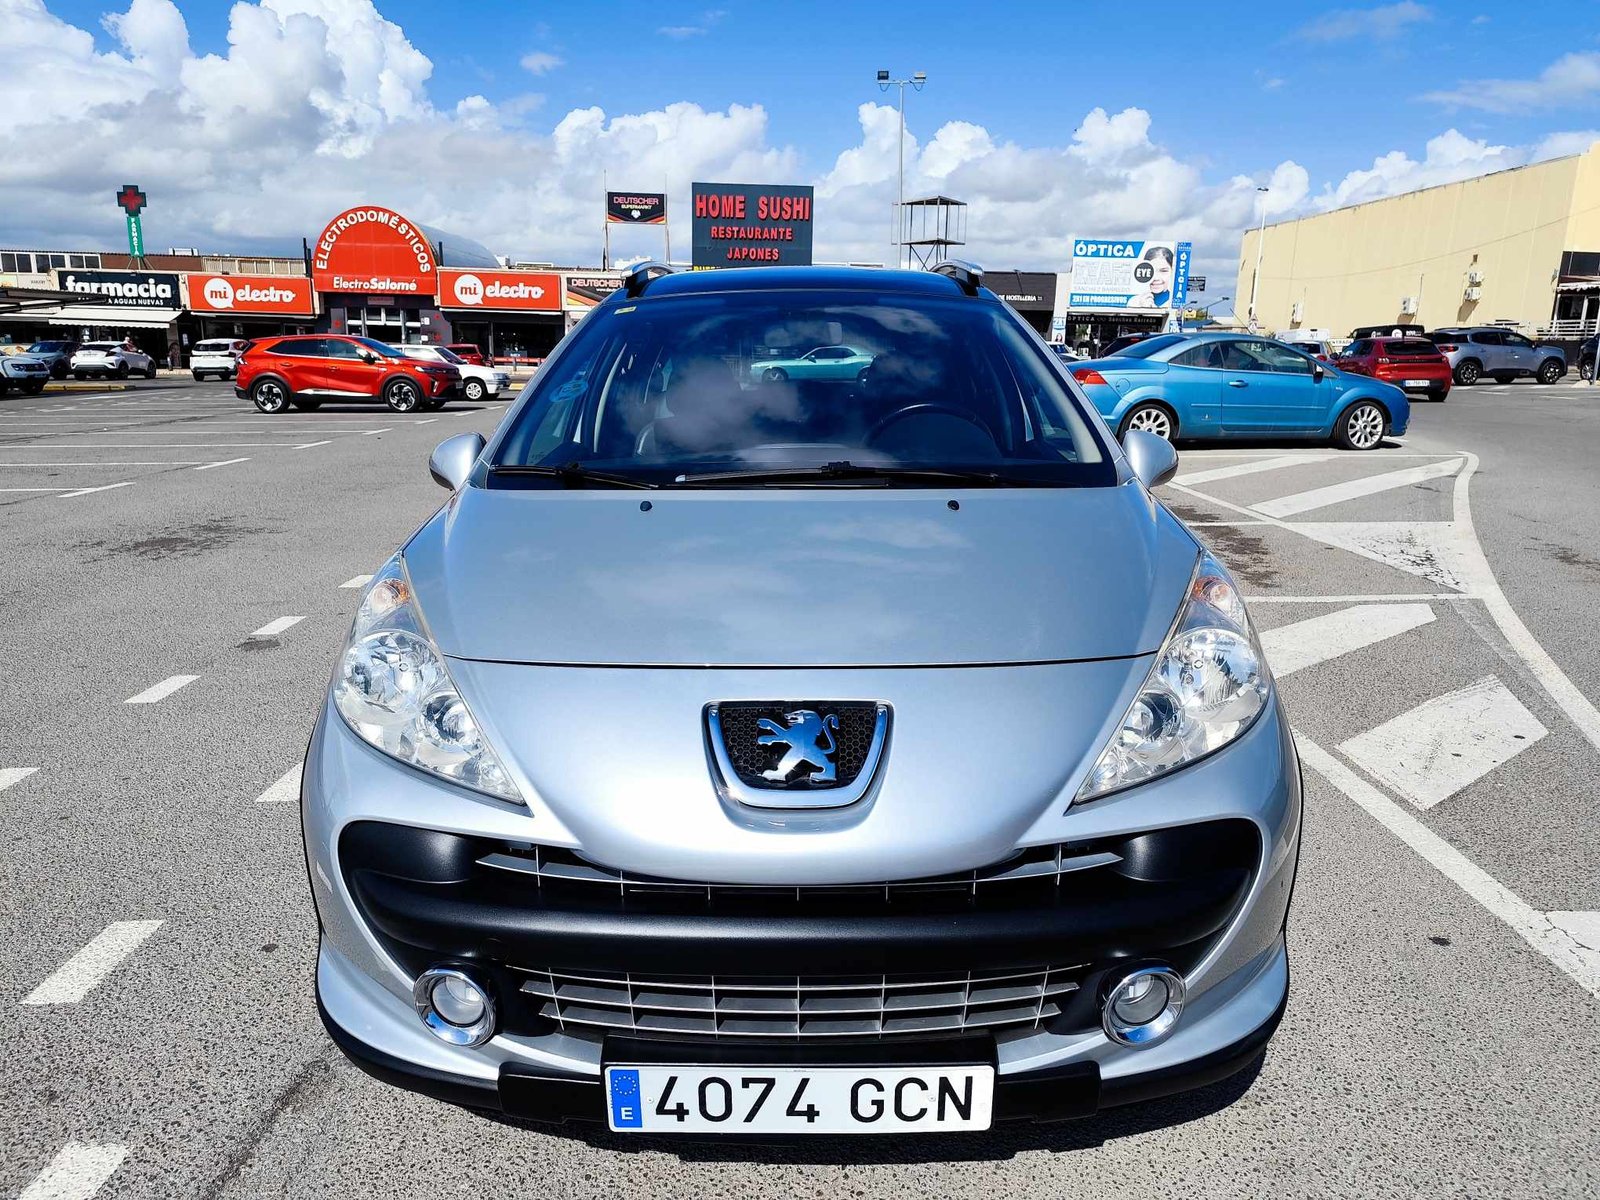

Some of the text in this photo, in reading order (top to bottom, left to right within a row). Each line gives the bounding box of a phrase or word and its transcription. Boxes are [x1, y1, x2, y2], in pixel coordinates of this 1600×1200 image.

[613, 196, 659, 205] DEUTSCHER
[695, 194, 810, 221] HOME SUSHI
[131, 217, 140, 256] FARMACIA
[316, 210, 431, 273] ELECTRODOMÉSTICOS
[710, 226, 793, 241] RESTAURANTE
[727, 247, 780, 261] JAPONES
[1075, 240, 1135, 257] ÓPTICA
[1136, 268, 1152, 278] EYE
[65, 275, 172, 298] farmacia
[460, 280, 545, 299] mi electro
[571, 278, 623, 288] DEUTSCHER
[210, 283, 296, 302] mi electro
[655, 1076, 820, 1123] 4074
[850, 1076, 973, 1123] GCN
[620, 1107, 634, 1121] E
